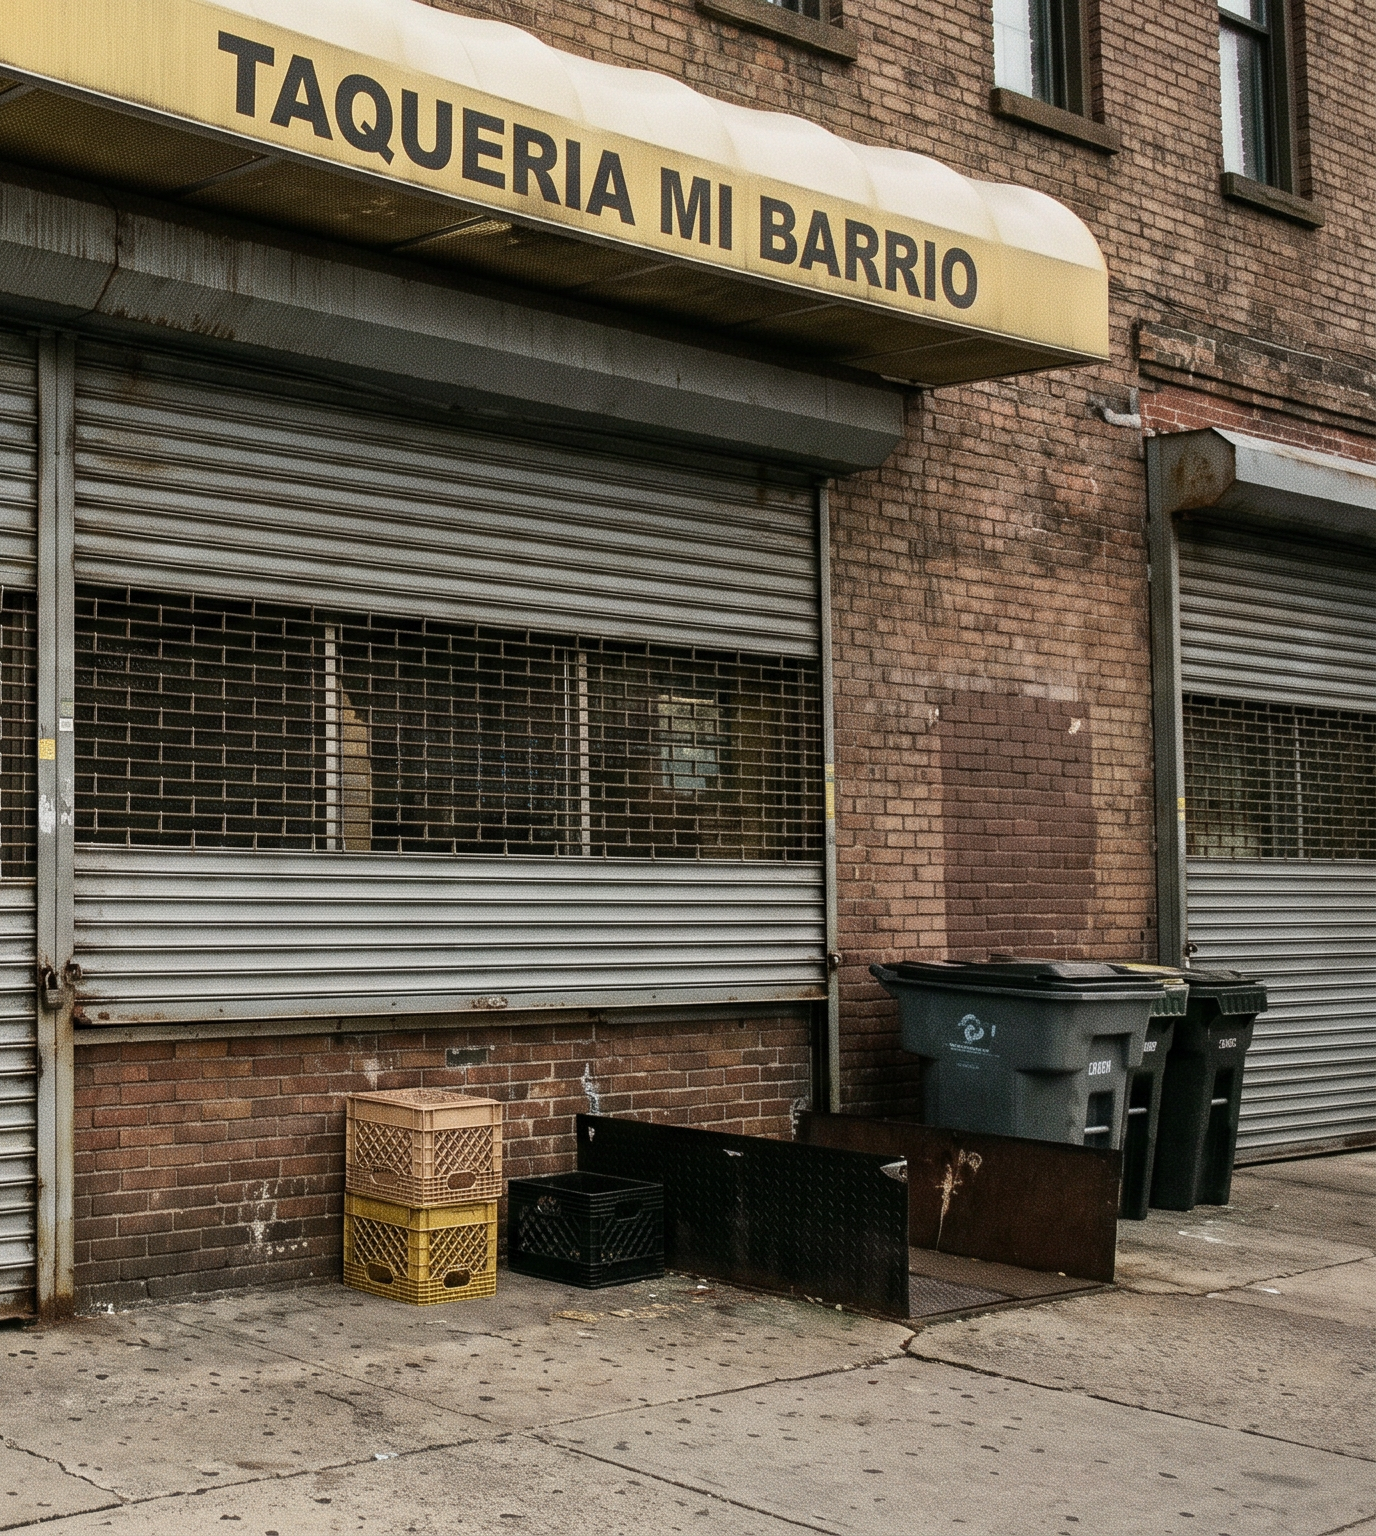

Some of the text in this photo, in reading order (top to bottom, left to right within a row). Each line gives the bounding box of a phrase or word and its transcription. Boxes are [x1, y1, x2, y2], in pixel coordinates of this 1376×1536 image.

[217, 29, 978, 310] TAQUERIA MI BARRIO
